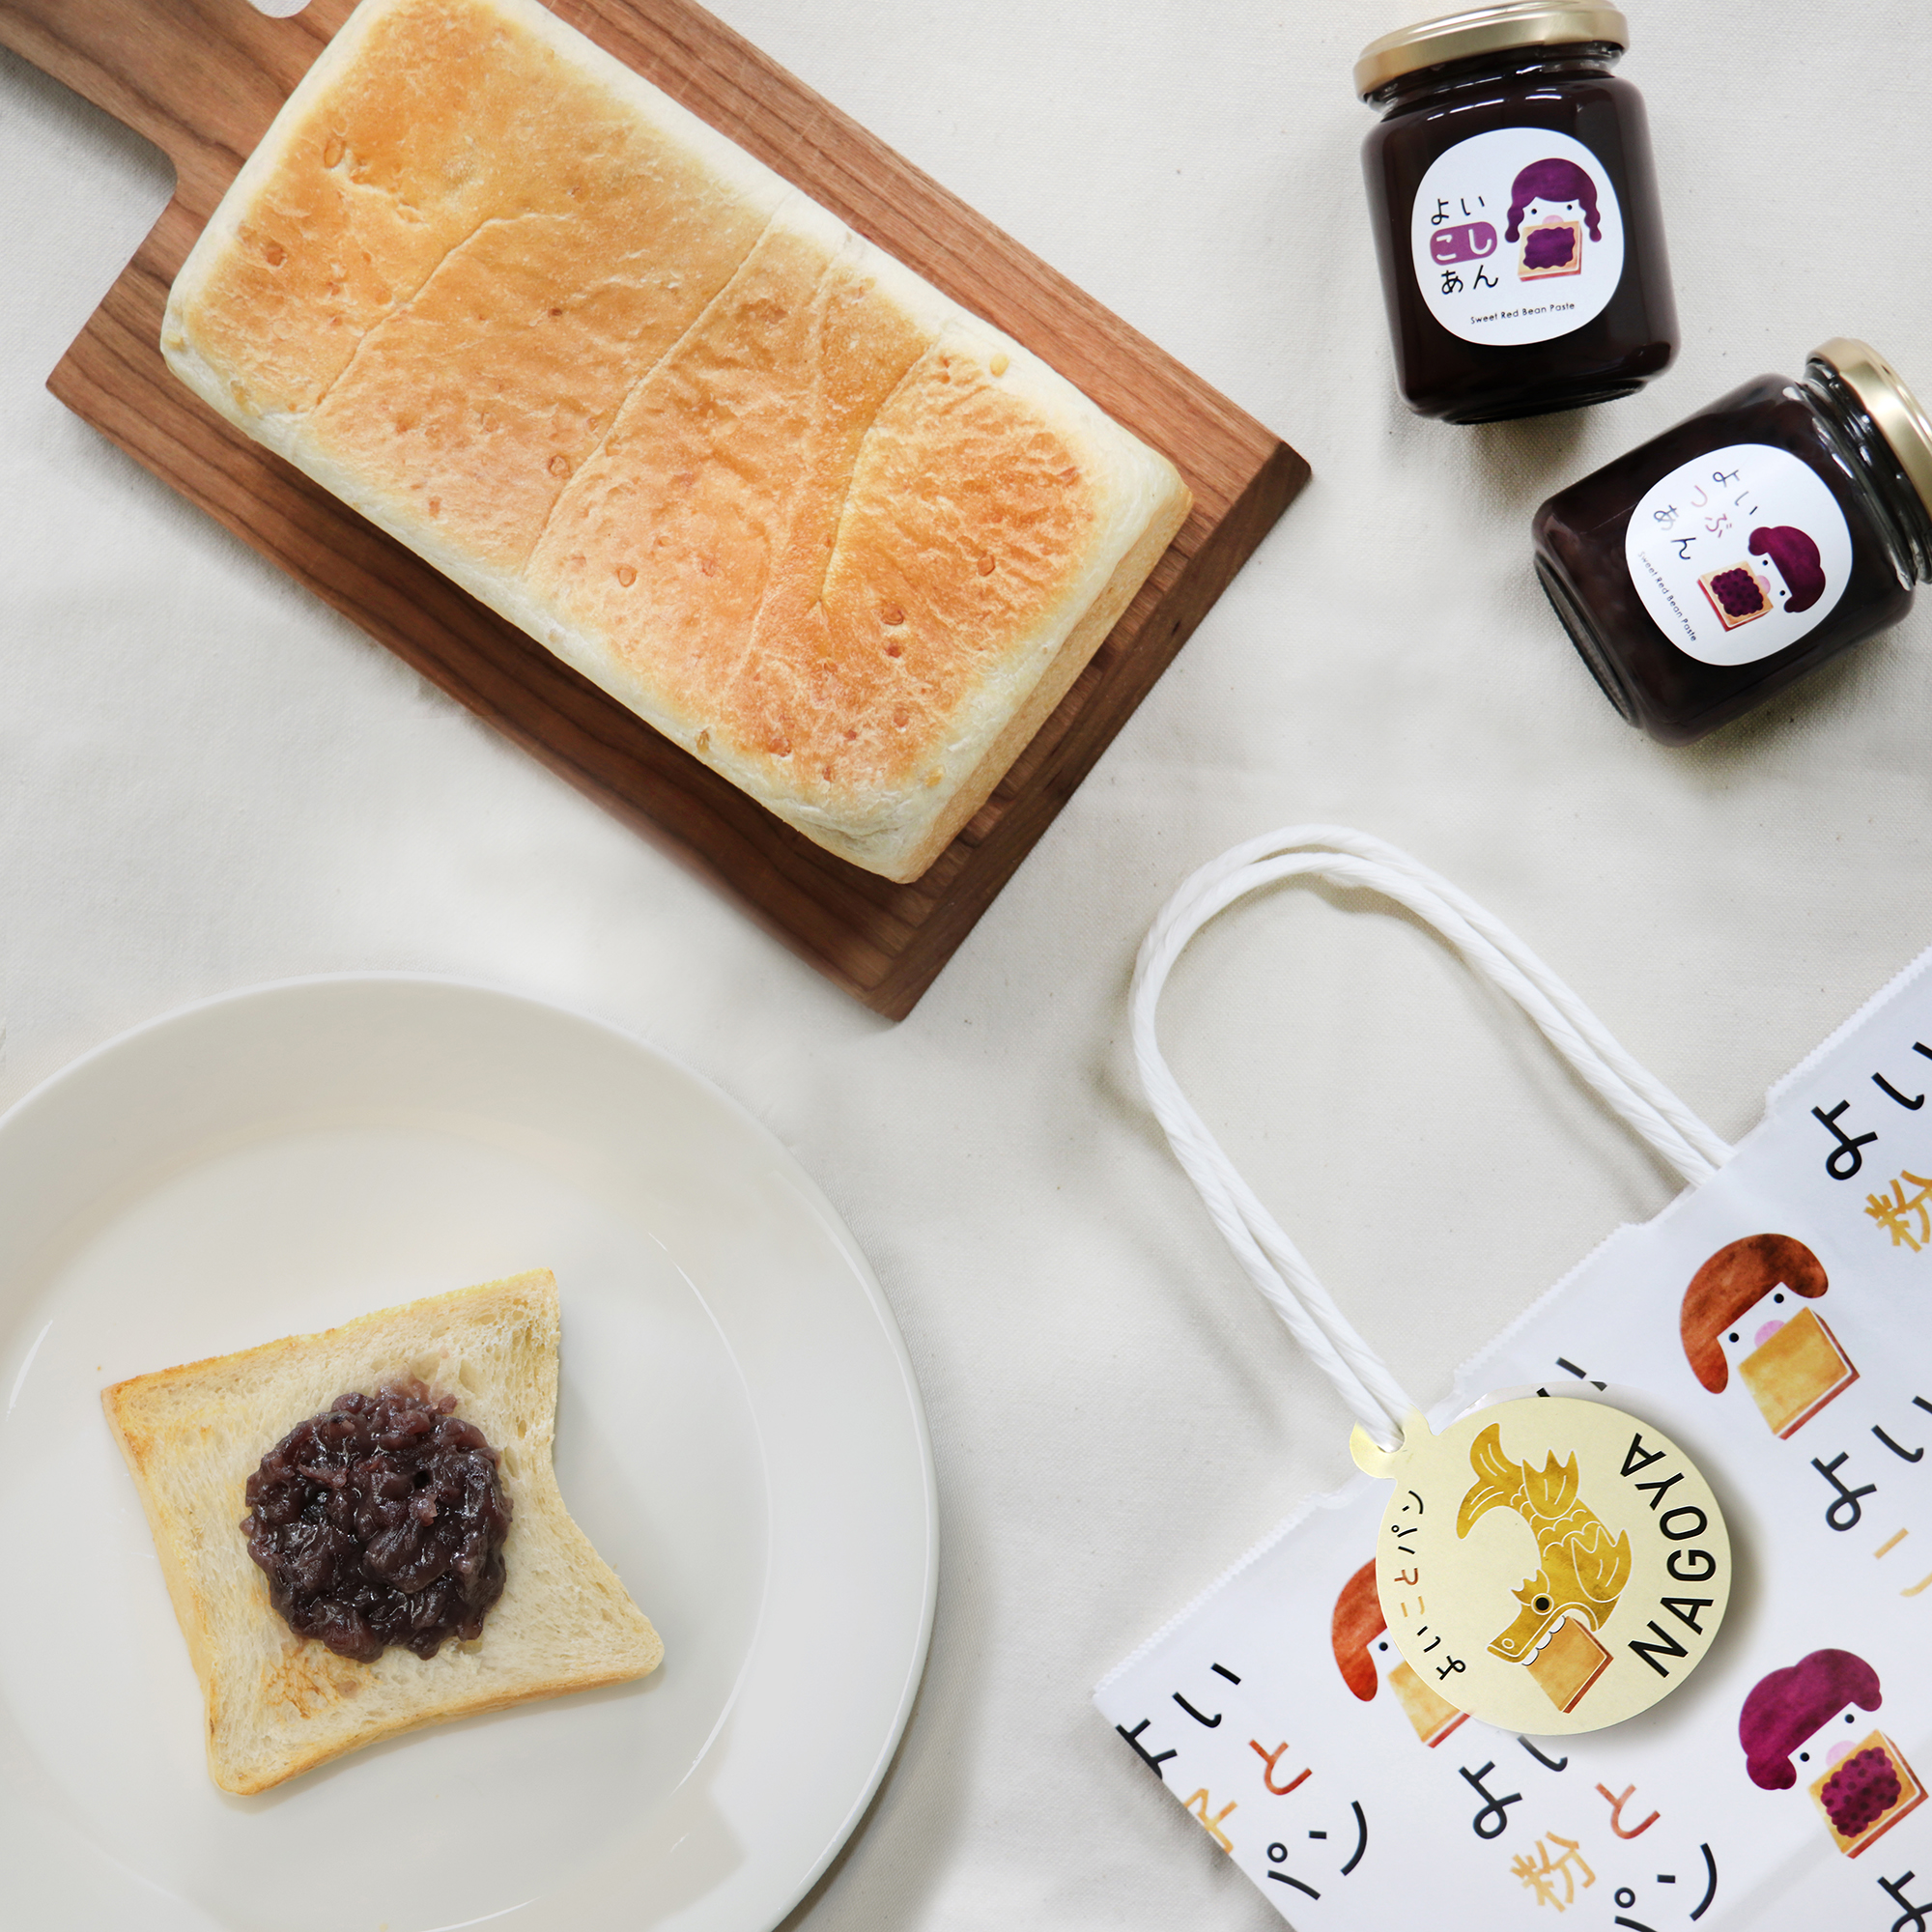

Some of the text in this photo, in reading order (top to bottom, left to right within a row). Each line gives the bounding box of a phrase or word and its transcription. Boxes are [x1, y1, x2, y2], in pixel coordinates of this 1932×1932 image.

[1431, 196, 1485, 225] よい
[1436, 228, 1492, 261] こし
[1441, 265, 1498, 295] あん
[1470, 302, 1576, 325] Sweet Red Bean Paste
[1690, 485, 1732, 538] つぶ
[1712, 469, 1758, 516] よい
[1653, 504, 1697, 560] あん
[1637, 551, 1697, 642] Sweet Red Bean Paste
[1619, 1432, 1717, 1679] NAGOYA
[1391, 1491, 1466, 1681] よいことパン
